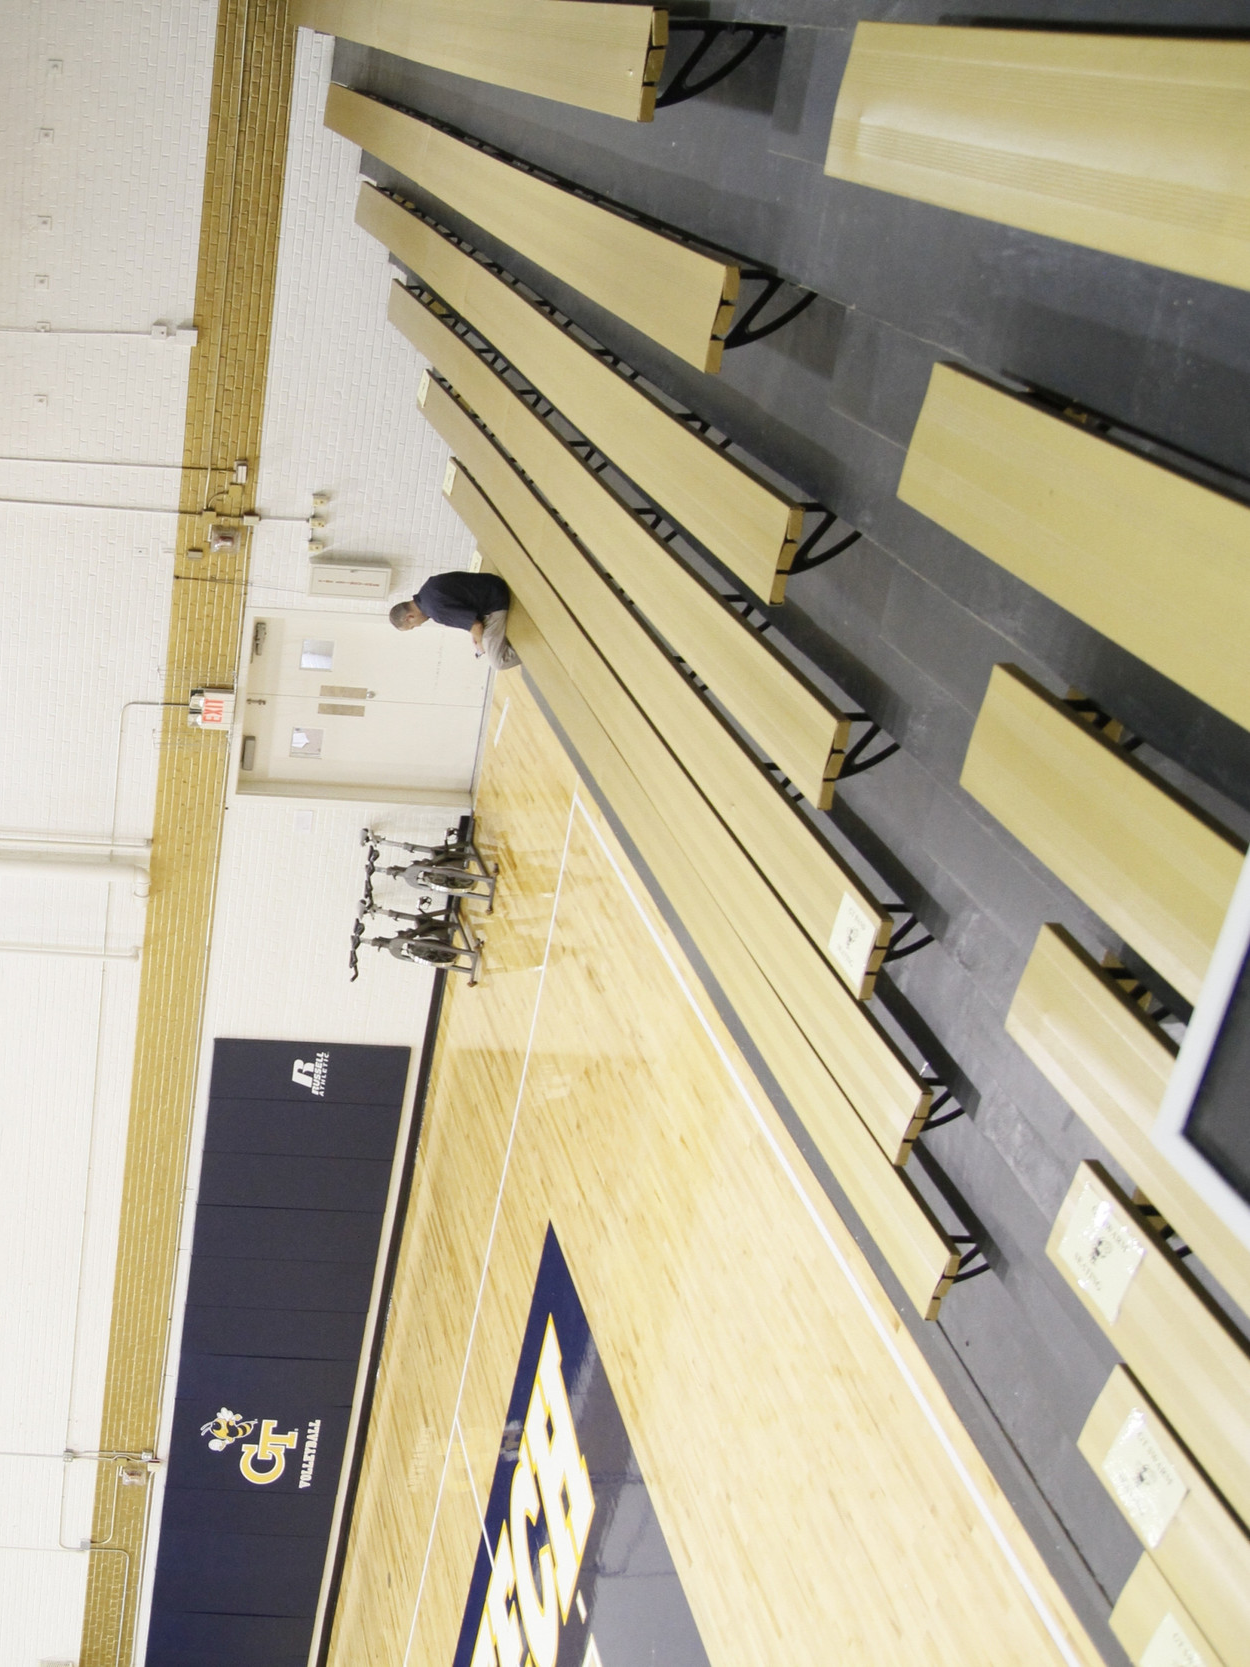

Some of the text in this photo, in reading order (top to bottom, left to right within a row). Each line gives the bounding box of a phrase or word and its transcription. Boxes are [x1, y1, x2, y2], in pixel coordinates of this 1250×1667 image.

[202, 698, 224, 723] EXIT
[312, 1051, 324, 1095] RUSSELL
[319, 1051, 330, 1097] ATHLETIC
[239, 1419, 299, 1485] GT
[298, 1419, 321, 1489] VOLLEYBALL
[470, 1313, 595, 1667] ECH
